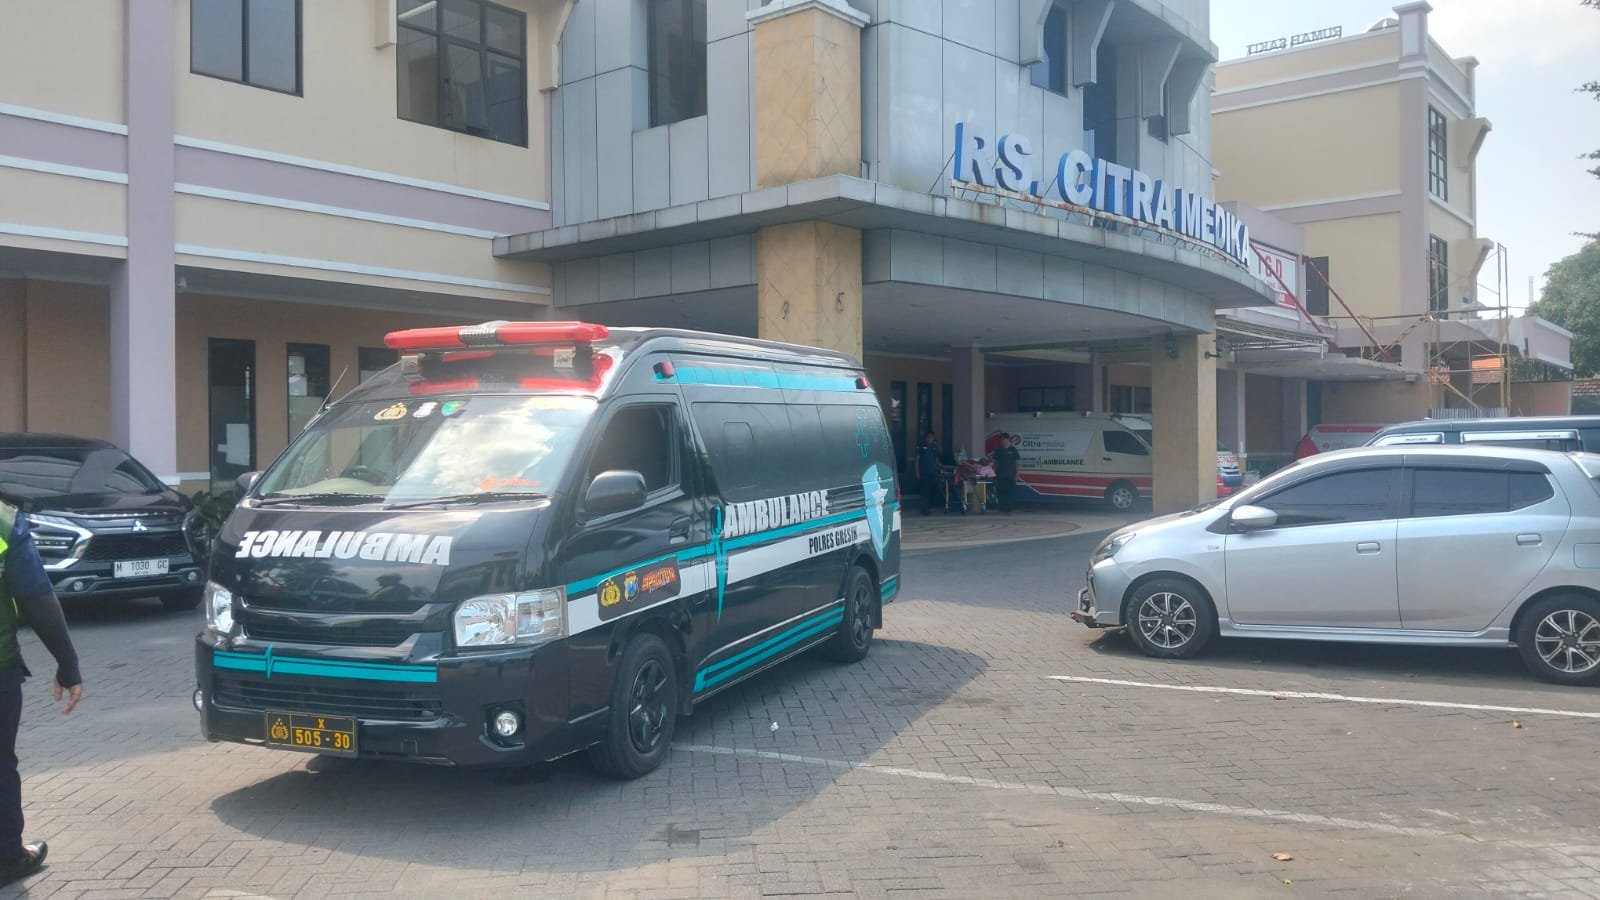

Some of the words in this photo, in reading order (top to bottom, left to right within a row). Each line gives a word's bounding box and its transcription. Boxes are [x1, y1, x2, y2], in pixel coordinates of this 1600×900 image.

[953, 121, 1044, 198] RS.
[1057, 149, 1176, 231] CITRA
[1174, 187, 1252, 268] MEDIKA
[1043, 458, 1084, 466] AMBULANCE
[723, 489, 830, 539] AMBULANCE
[809, 532, 835, 555] POLRES
[318, 718, 325, 729] X
[295, 729, 321, 746] 505
[334, 732, 350, 749] 30
